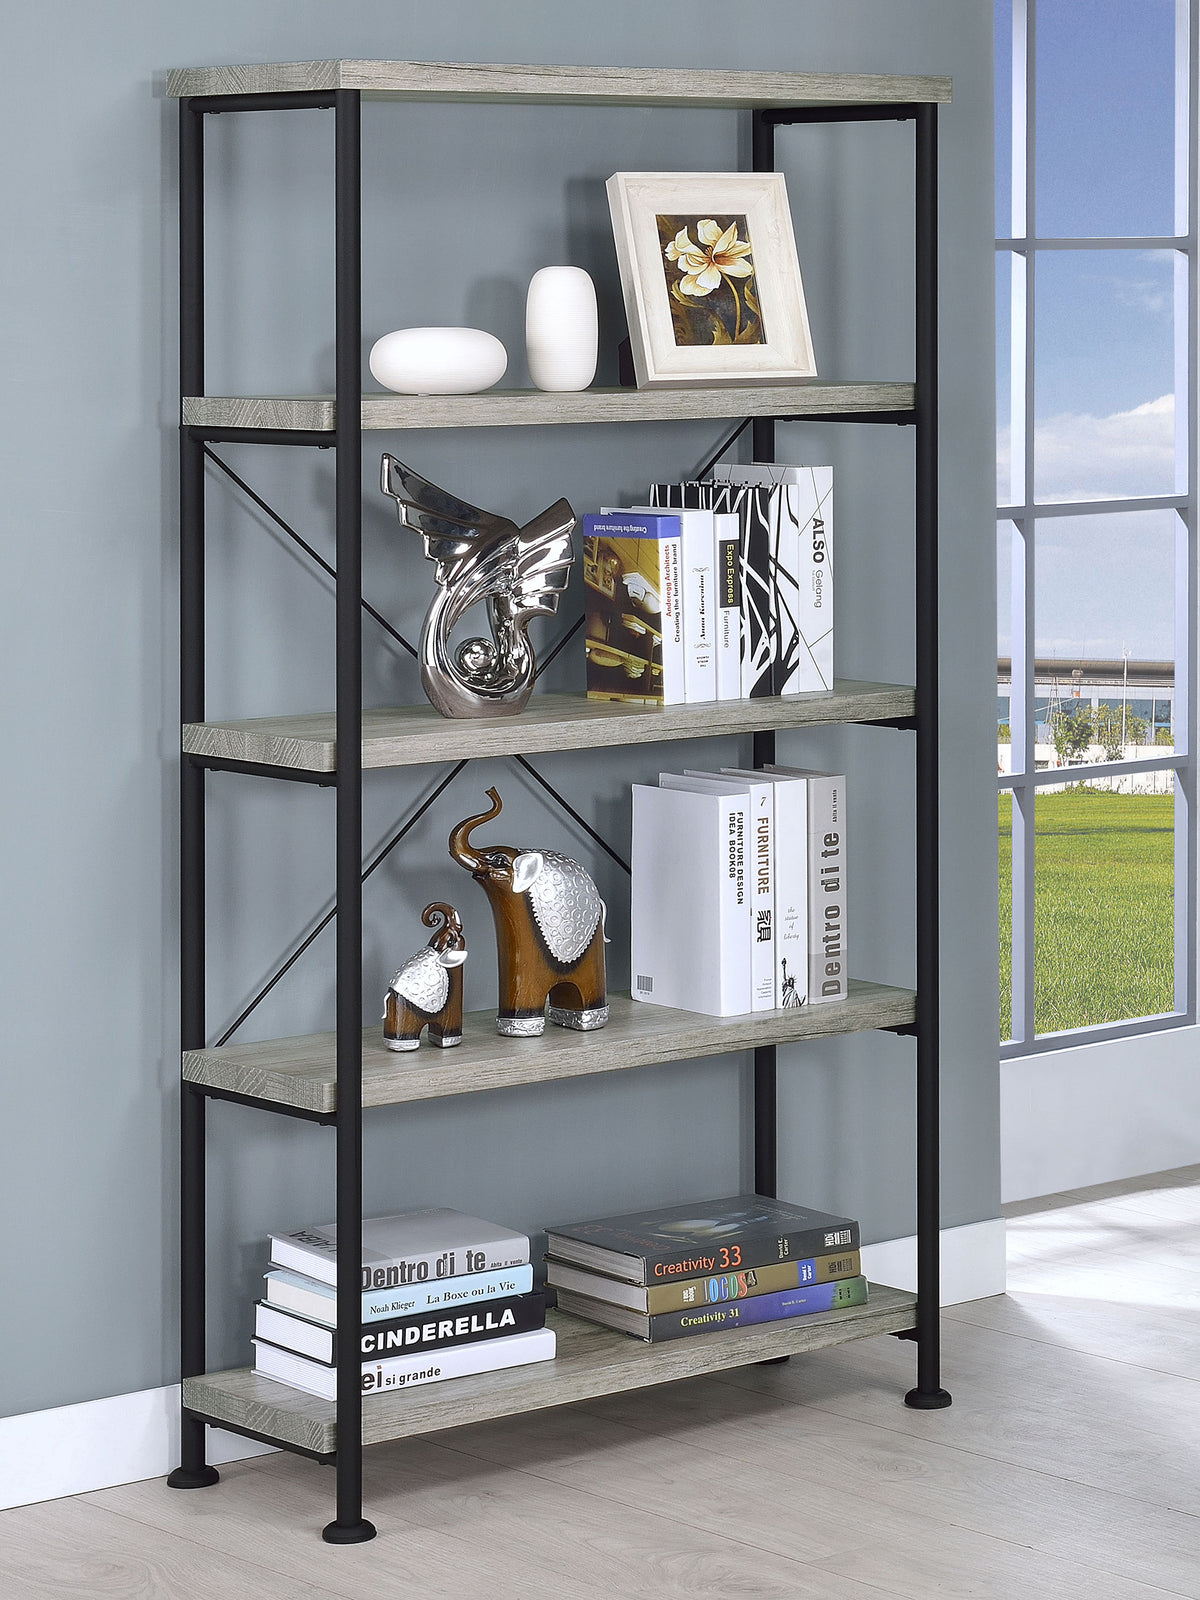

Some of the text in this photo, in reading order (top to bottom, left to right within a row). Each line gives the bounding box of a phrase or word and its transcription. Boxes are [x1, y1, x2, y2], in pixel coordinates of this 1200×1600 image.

[594, 524, 606, 532] brand
[630, 524, 647, 534] Creating
[726, 544, 735, 604] Expo Express
[812, 518, 824, 608] ALSO Gelang
[723, 610, 731, 648] Furniture
[728, 812, 736, 835] IDEA
[736, 812, 744, 866] FURNITURE
[757, 817, 770, 894] FURNITURE
[756, 910, 772, 943] 家具
[820, 832, 841, 997] Dentro di te
[362, 1250, 486, 1290] Dentro di te
[654, 1246, 742, 1277] Creativity 33
[370, 1280, 516, 1315] Noah Klieger La Boxe ou la Vie
[360, 1308, 516, 1354] CINDERELLA
[680, 1308, 740, 1327] Creativity 31
[385, 1374, 396, 1386] si
[398, 1366, 442, 1385] grande
